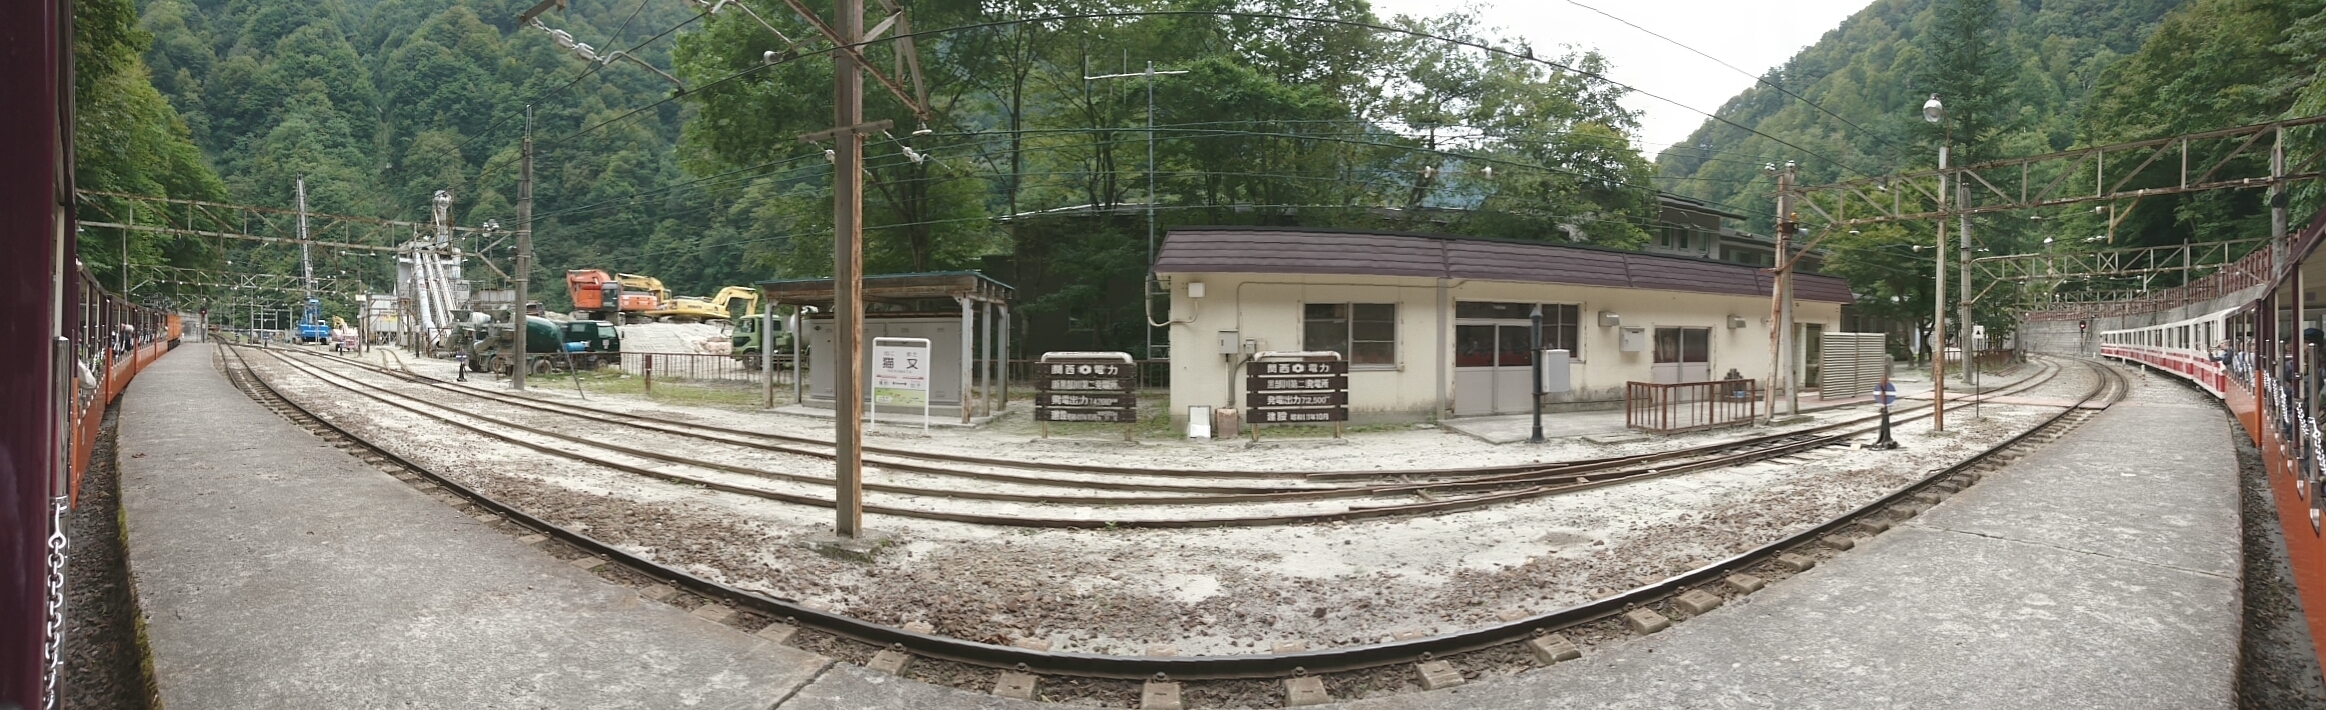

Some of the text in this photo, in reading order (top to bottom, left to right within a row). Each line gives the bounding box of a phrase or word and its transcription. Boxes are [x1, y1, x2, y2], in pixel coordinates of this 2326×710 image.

[1051, 364, 1119, 375] 関西 電力
[1267, 363, 1330, 373] 関西 電力
